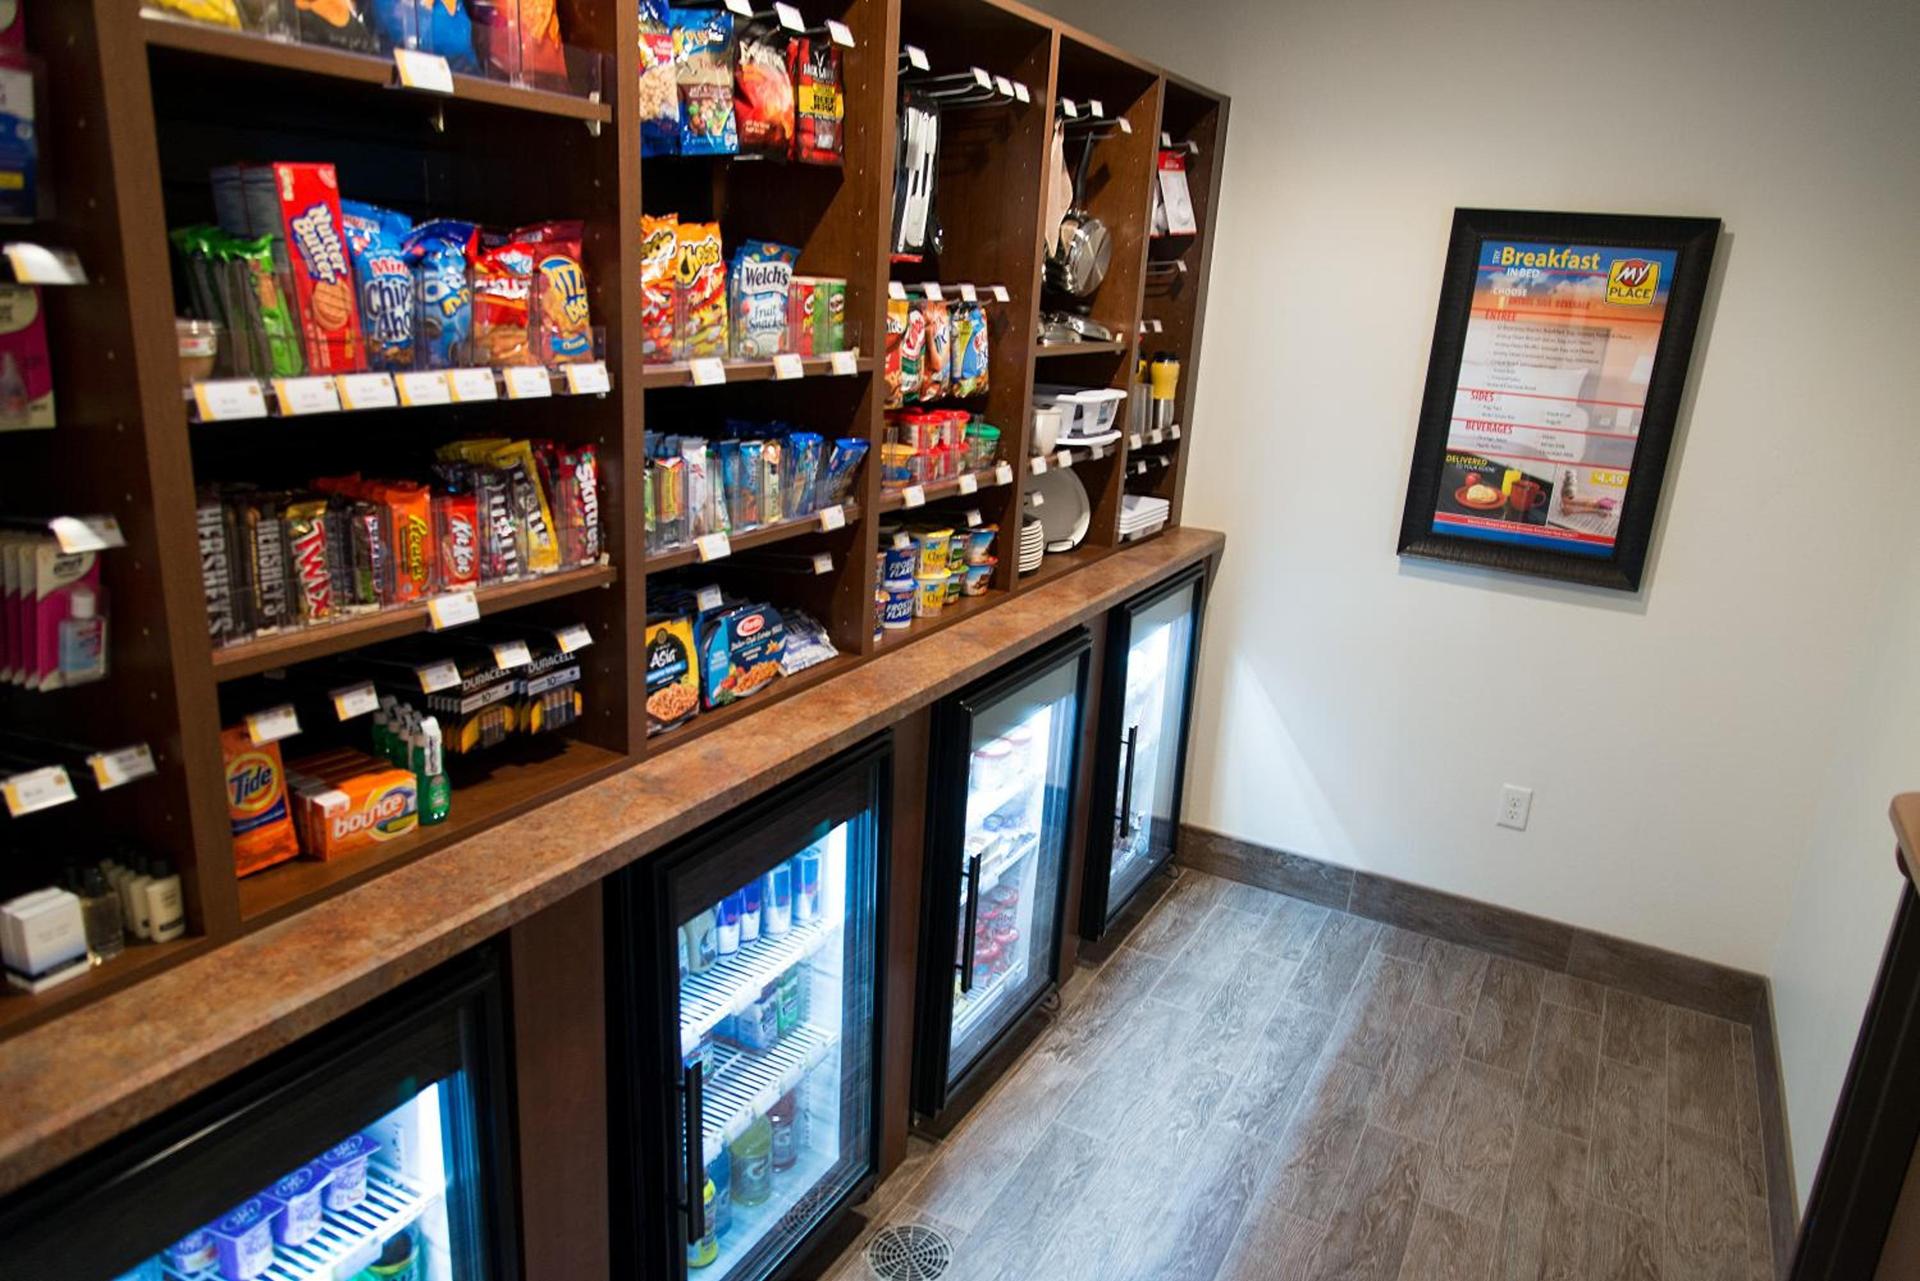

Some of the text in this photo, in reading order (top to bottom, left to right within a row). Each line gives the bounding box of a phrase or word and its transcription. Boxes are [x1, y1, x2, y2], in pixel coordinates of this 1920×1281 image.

[308, 203, 348, 275] Nutter
[292, 217, 337, 285] Butter
[1500, 246, 1601, 272] Breakfast
[744, 265, 790, 288] Welch's
[1506, 267, 1541, 279] IN BED
[1615, 262, 1652, 285] MY
[1492, 286, 1529, 297] CHOOSE
[1608, 286, 1652, 300] PLACE
[753, 303, 777, 319] Fruit
[376, 311, 413, 341] Aho
[748, 318, 786, 331] Snacks
[1470, 390, 1495, 403] SIDES
[1465, 420, 1514, 435] BEVERAGES
[1445, 453, 1489, 467] DELIVERED
[196, 504, 234, 636] HERSHEY'S
[256, 518, 288, 618] HERSHEY'S
[290, 517, 334, 622] TWIX
[528, 651, 577, 674] DURACELL
[649, 647, 678, 669] Asia
[462, 667, 512, 691] DURACELL
[229, 766, 272, 805] Tide
[333, 793, 405, 840] bounce
